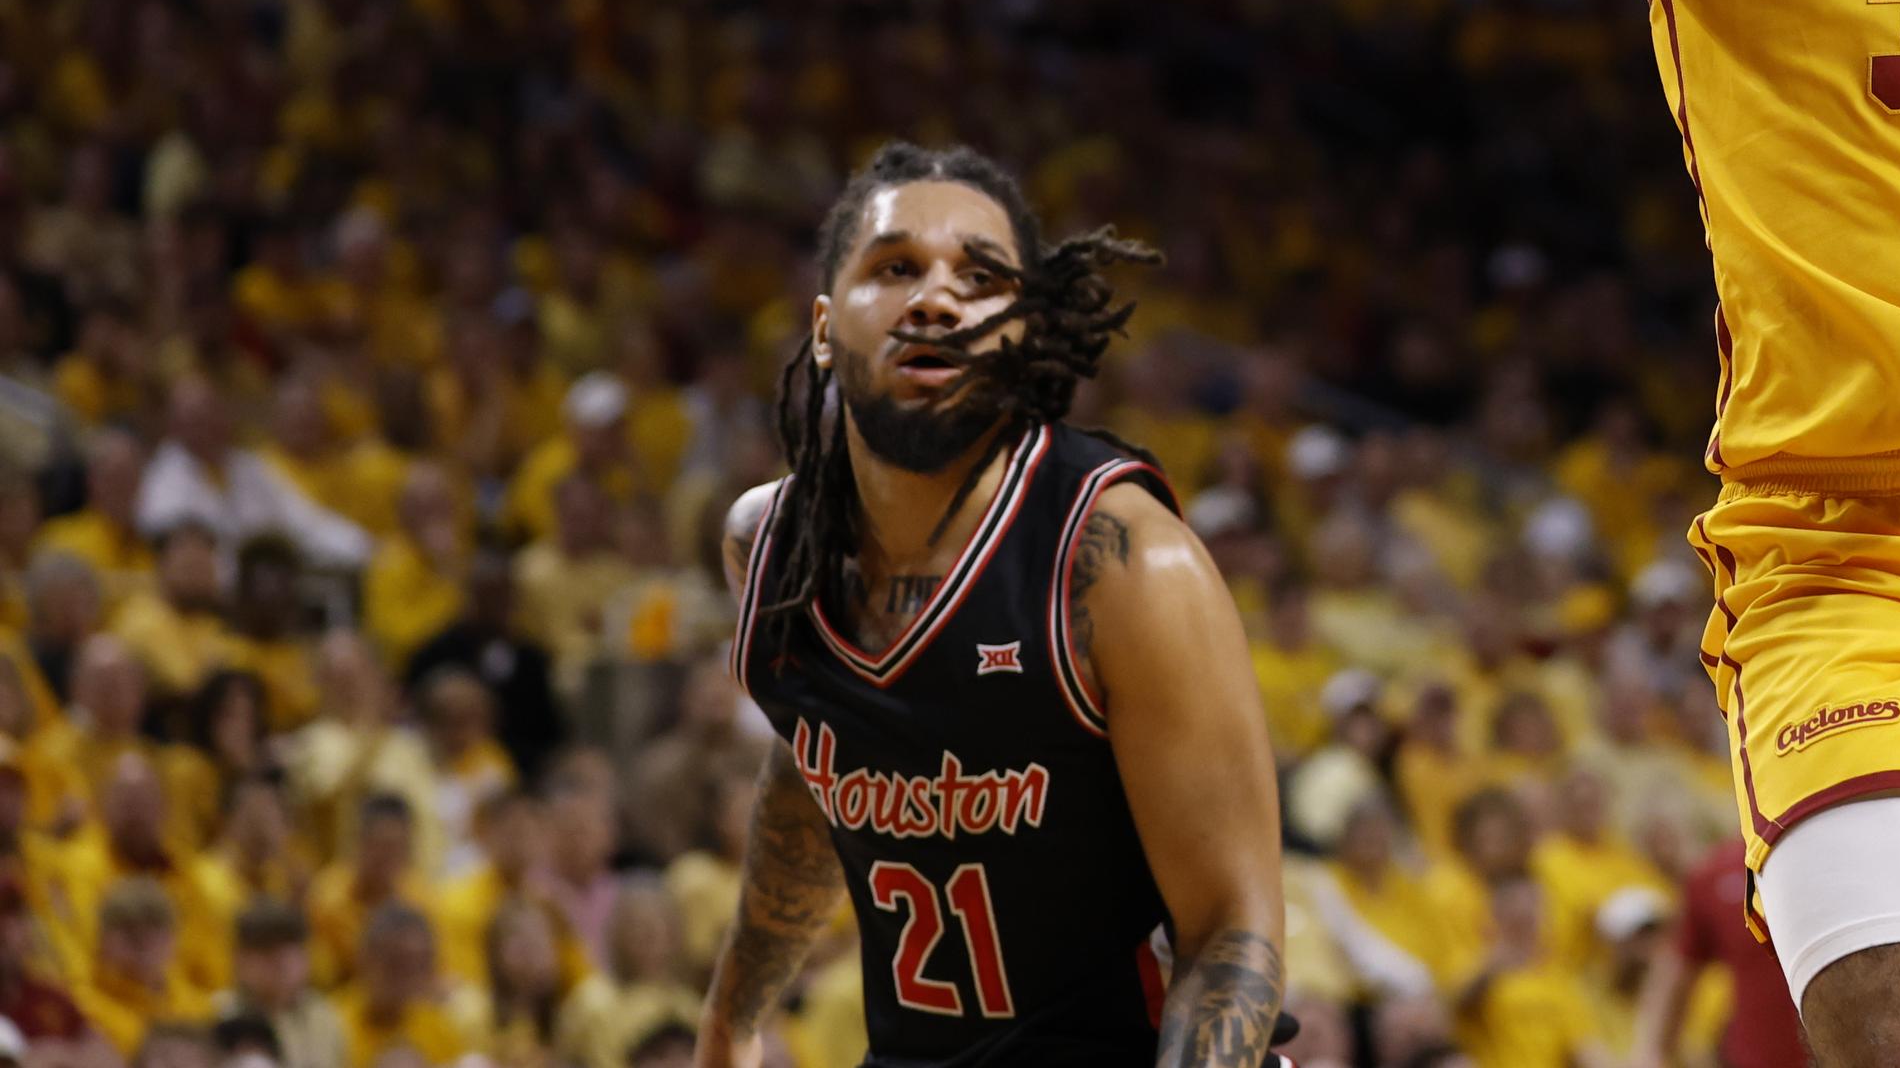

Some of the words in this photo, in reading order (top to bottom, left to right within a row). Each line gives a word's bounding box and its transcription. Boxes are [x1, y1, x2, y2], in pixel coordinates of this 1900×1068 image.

[793, 716, 1050, 840] Houston
[1777, 700, 1900, 750] Cyclones
[868, 859, 1015, 1019] 21
